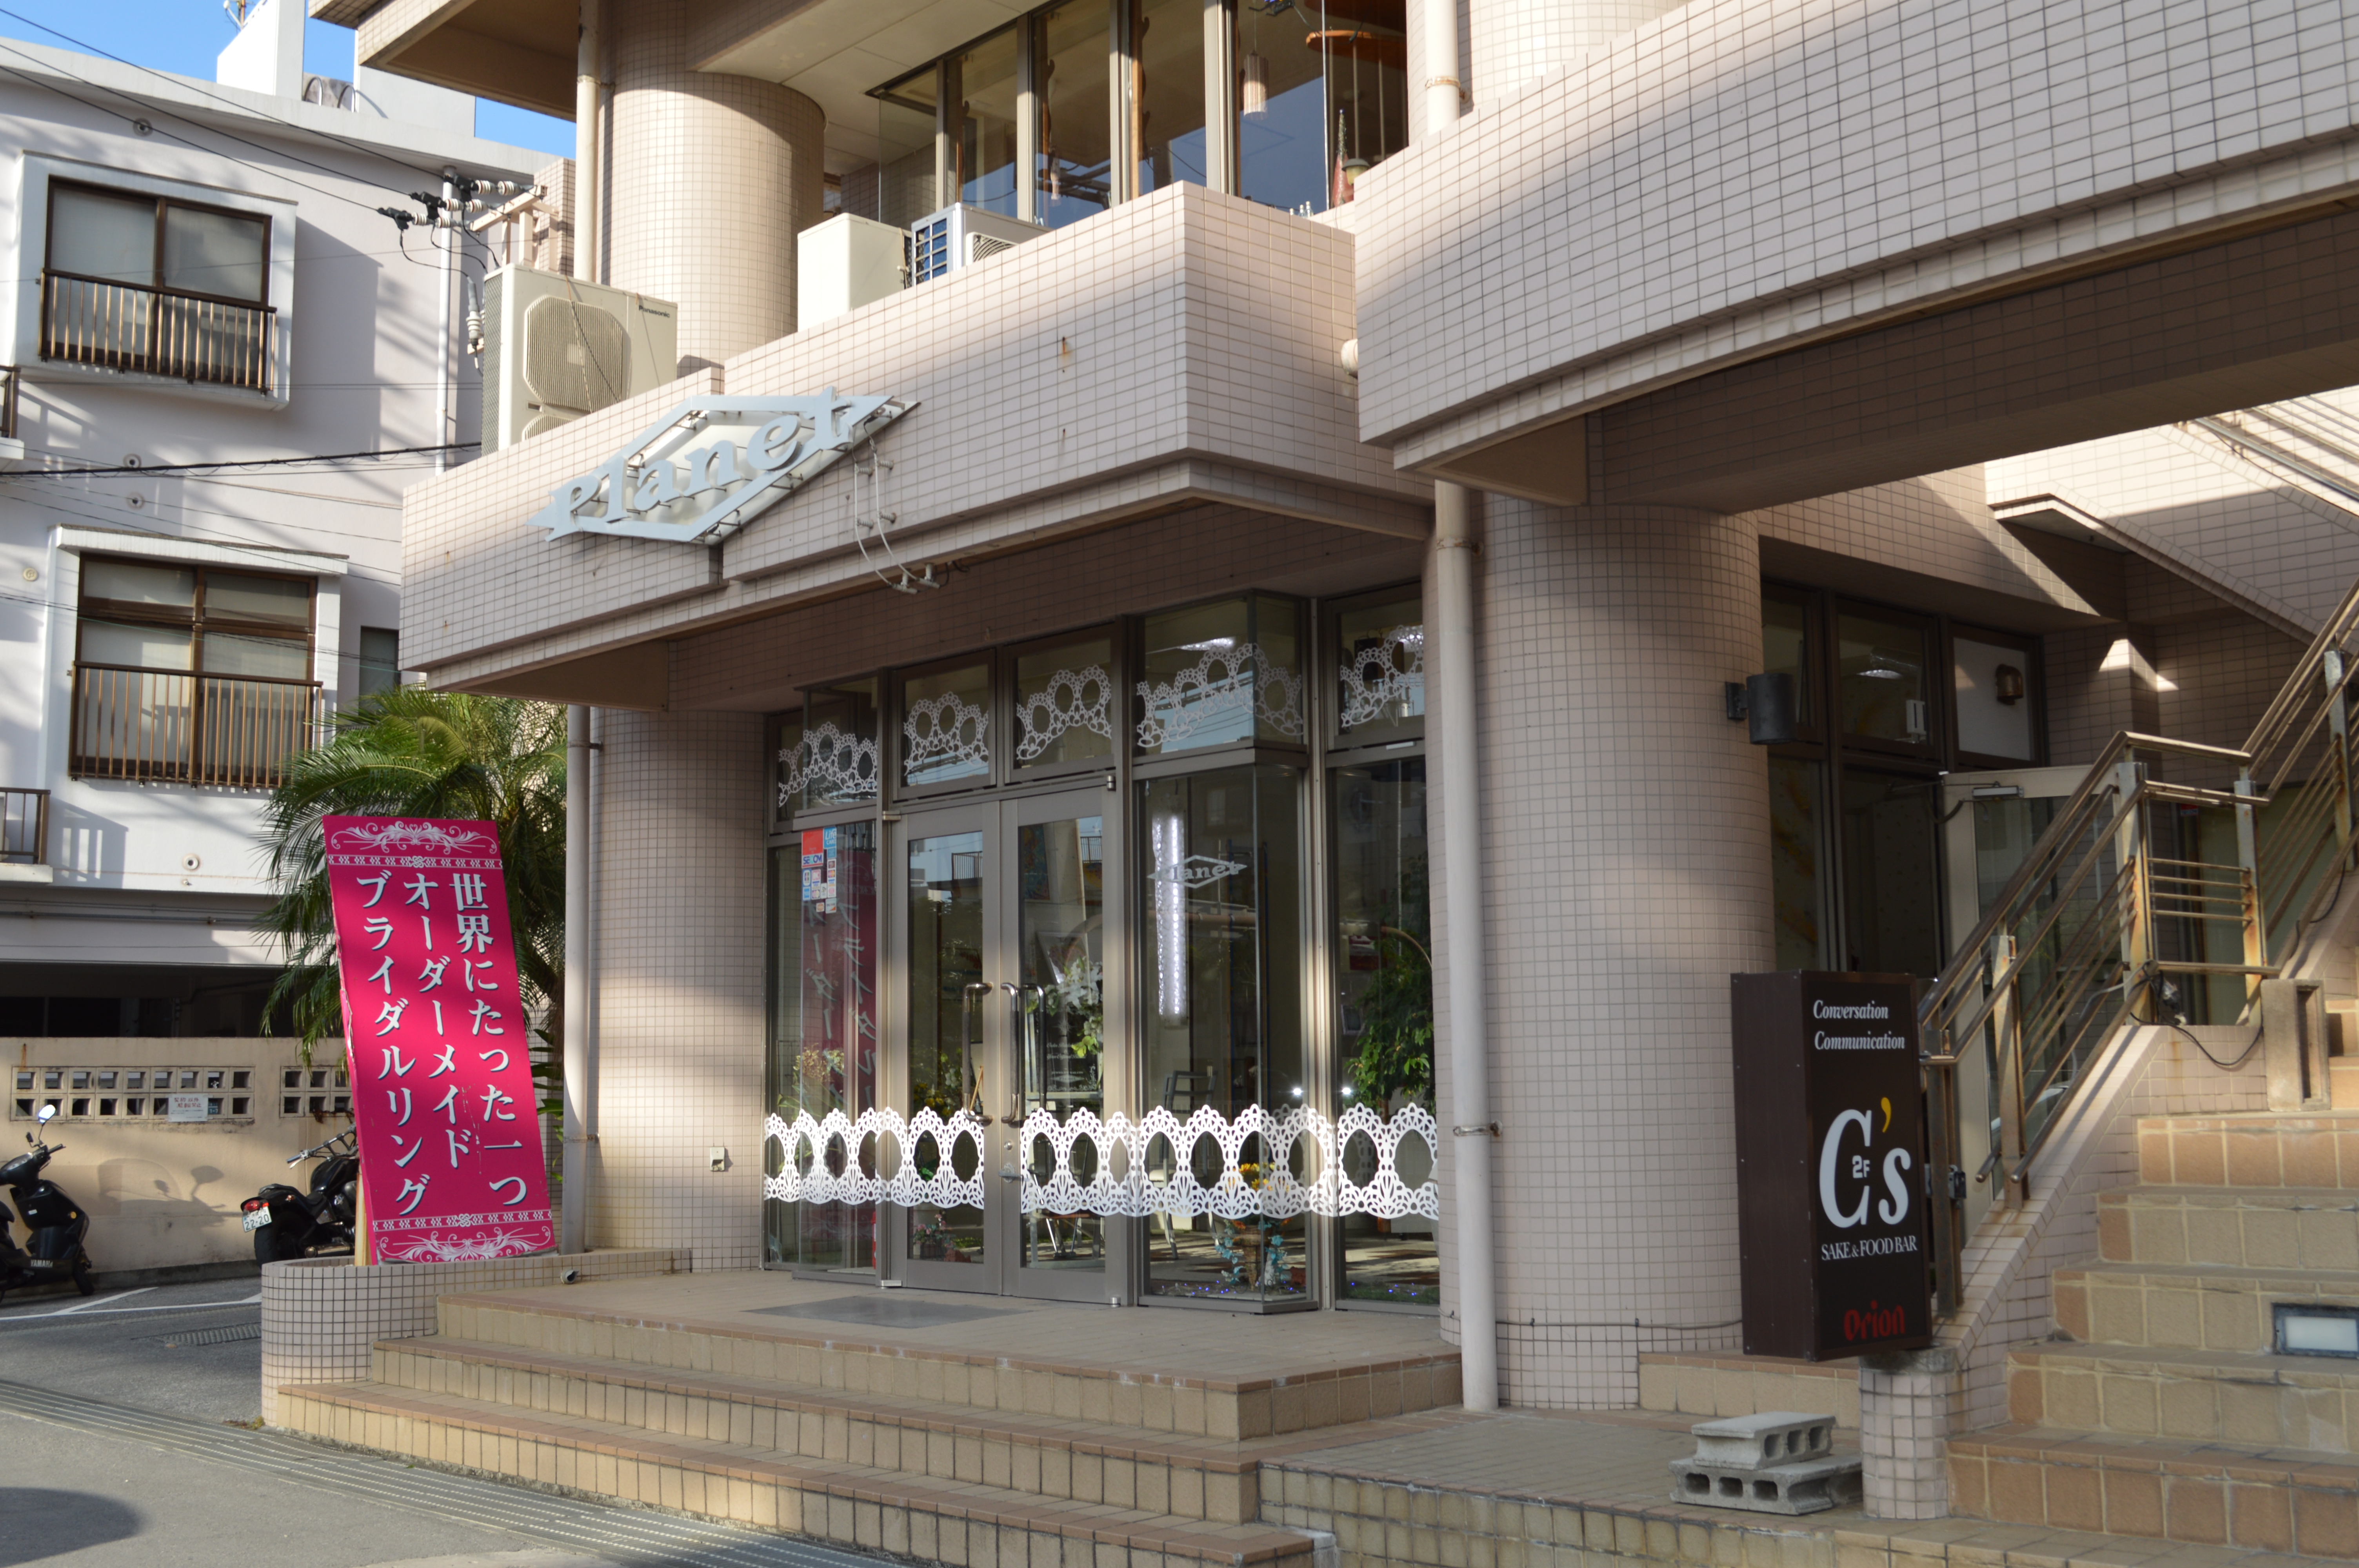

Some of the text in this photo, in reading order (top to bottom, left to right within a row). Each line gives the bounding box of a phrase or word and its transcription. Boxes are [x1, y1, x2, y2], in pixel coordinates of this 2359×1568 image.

[639, 305, 670, 318] Panasonic
[825, 828, 836, 840] Life
[803, 855, 822, 865] SECOM
[1813, 1000, 1888, 1019] Conversation
[403, 873, 472, 1169] オーダーメイド
[356, 869, 431, 1216] ブライダルリング
[449, 873, 527, 1205] 世界にたった一つ
[1814, 1031, 1905, 1050] Communication
[1819, 1097, 1911, 1228] C's
[1852, 1155, 1870, 1178] 2F
[1821, 1235, 1918, 1261] SAKE & FOOD BAR
[31, 1259, 53, 1268] YAMAHA
